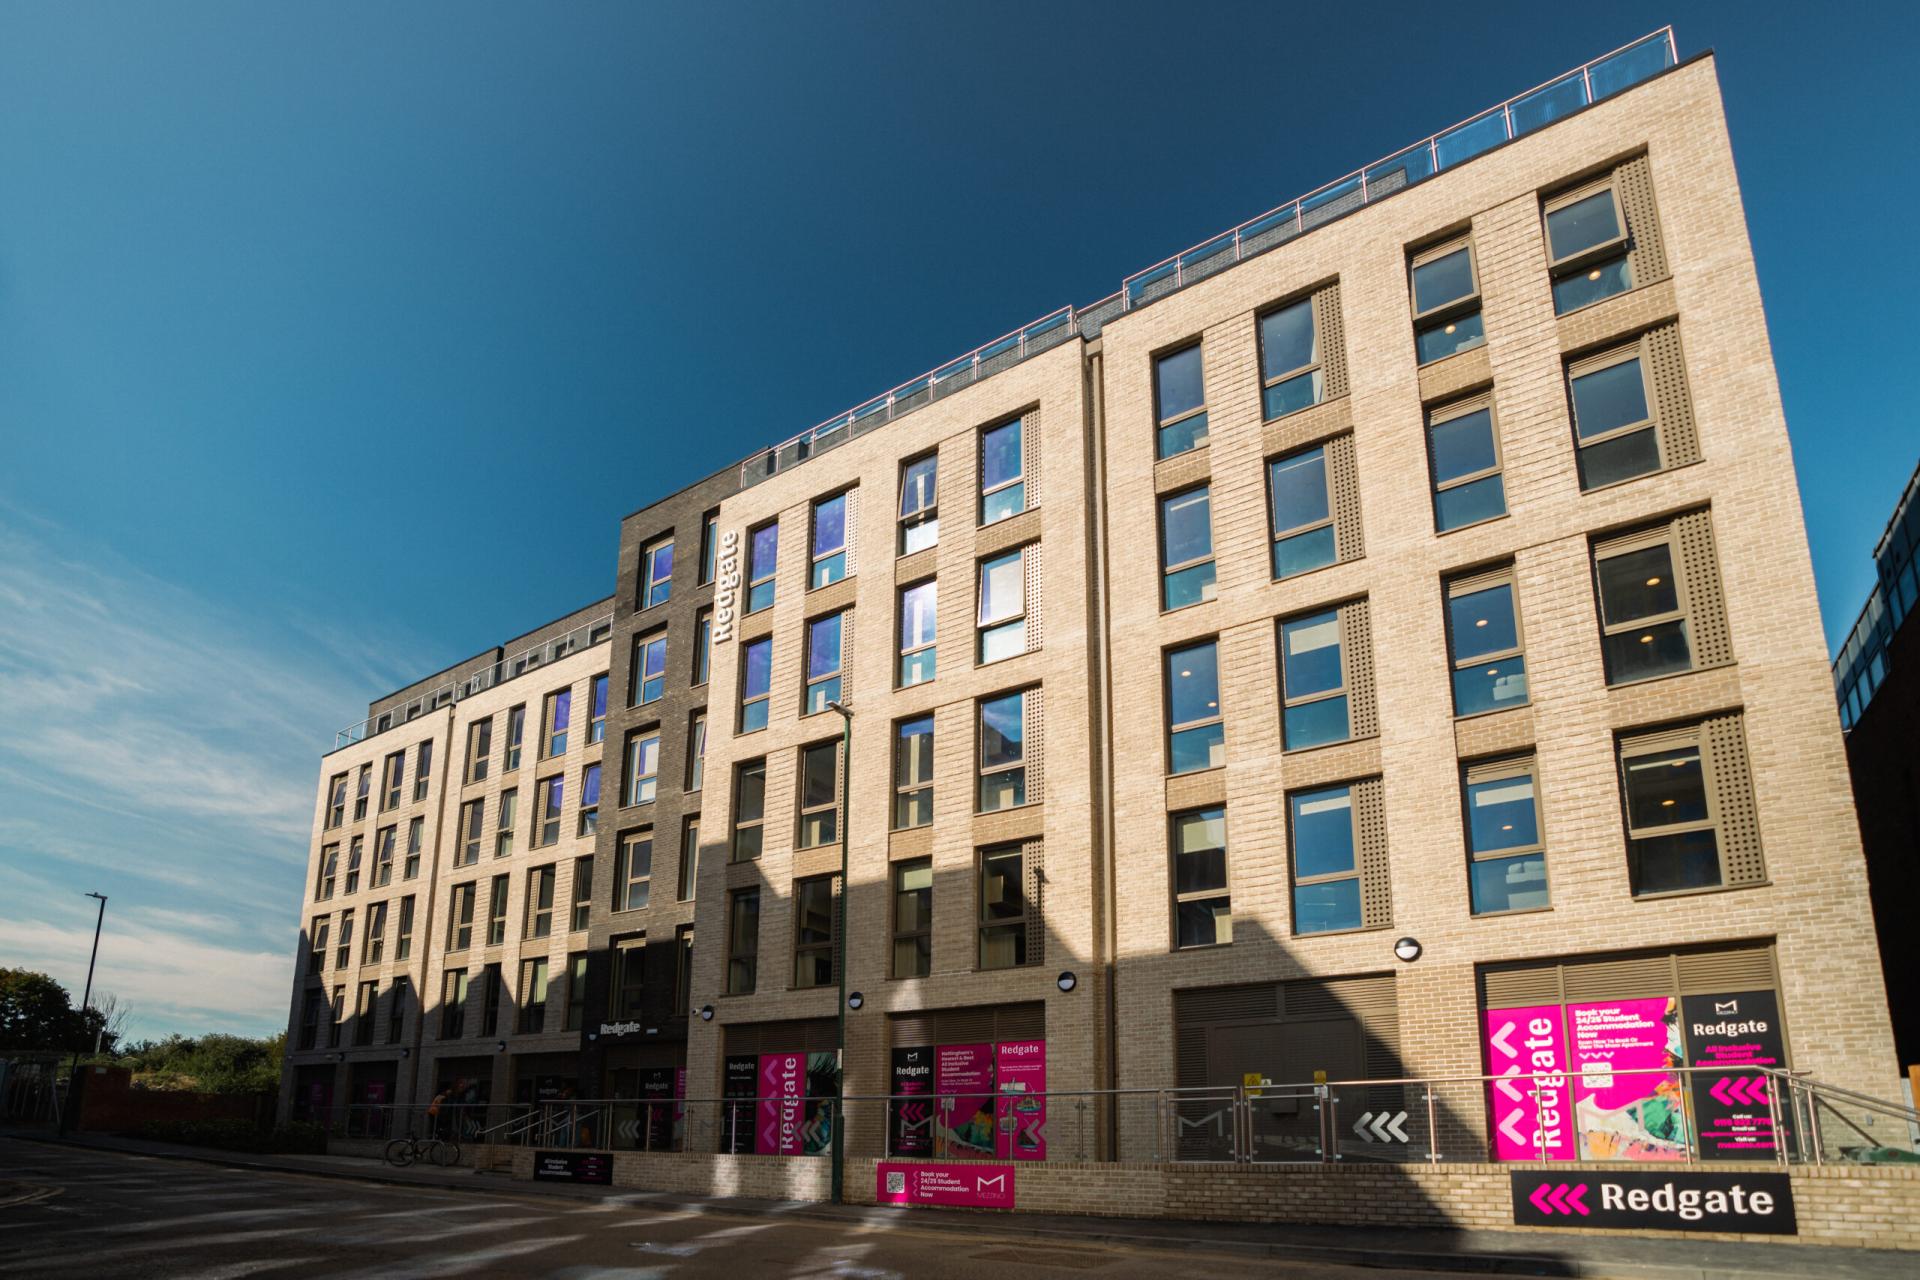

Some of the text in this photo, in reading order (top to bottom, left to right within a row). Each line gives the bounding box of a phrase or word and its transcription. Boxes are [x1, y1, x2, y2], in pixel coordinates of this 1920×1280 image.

[712, 529, 739, 645] Redgate
[1575, 1008, 1620, 1017] Book your
[1603, 1014, 1639, 1022] Student
[600, 1021, 640, 1036] Redgate
[1577, 1021, 1654, 1031] Accommodation
[1693, 1020, 1768, 1037] Redgate
[1002, 1044, 1039, 1056] Redgate
[729, 1062, 754, 1072] Redgate
[896, 1066, 930, 1076] Redgate
[645, 1082, 668, 1091] Redgate
[1524, 1018, 1566, 1147] Redgate
[781, 1057, 800, 1149] Redgate
[1601, 1183, 1774, 1220] Redgate
